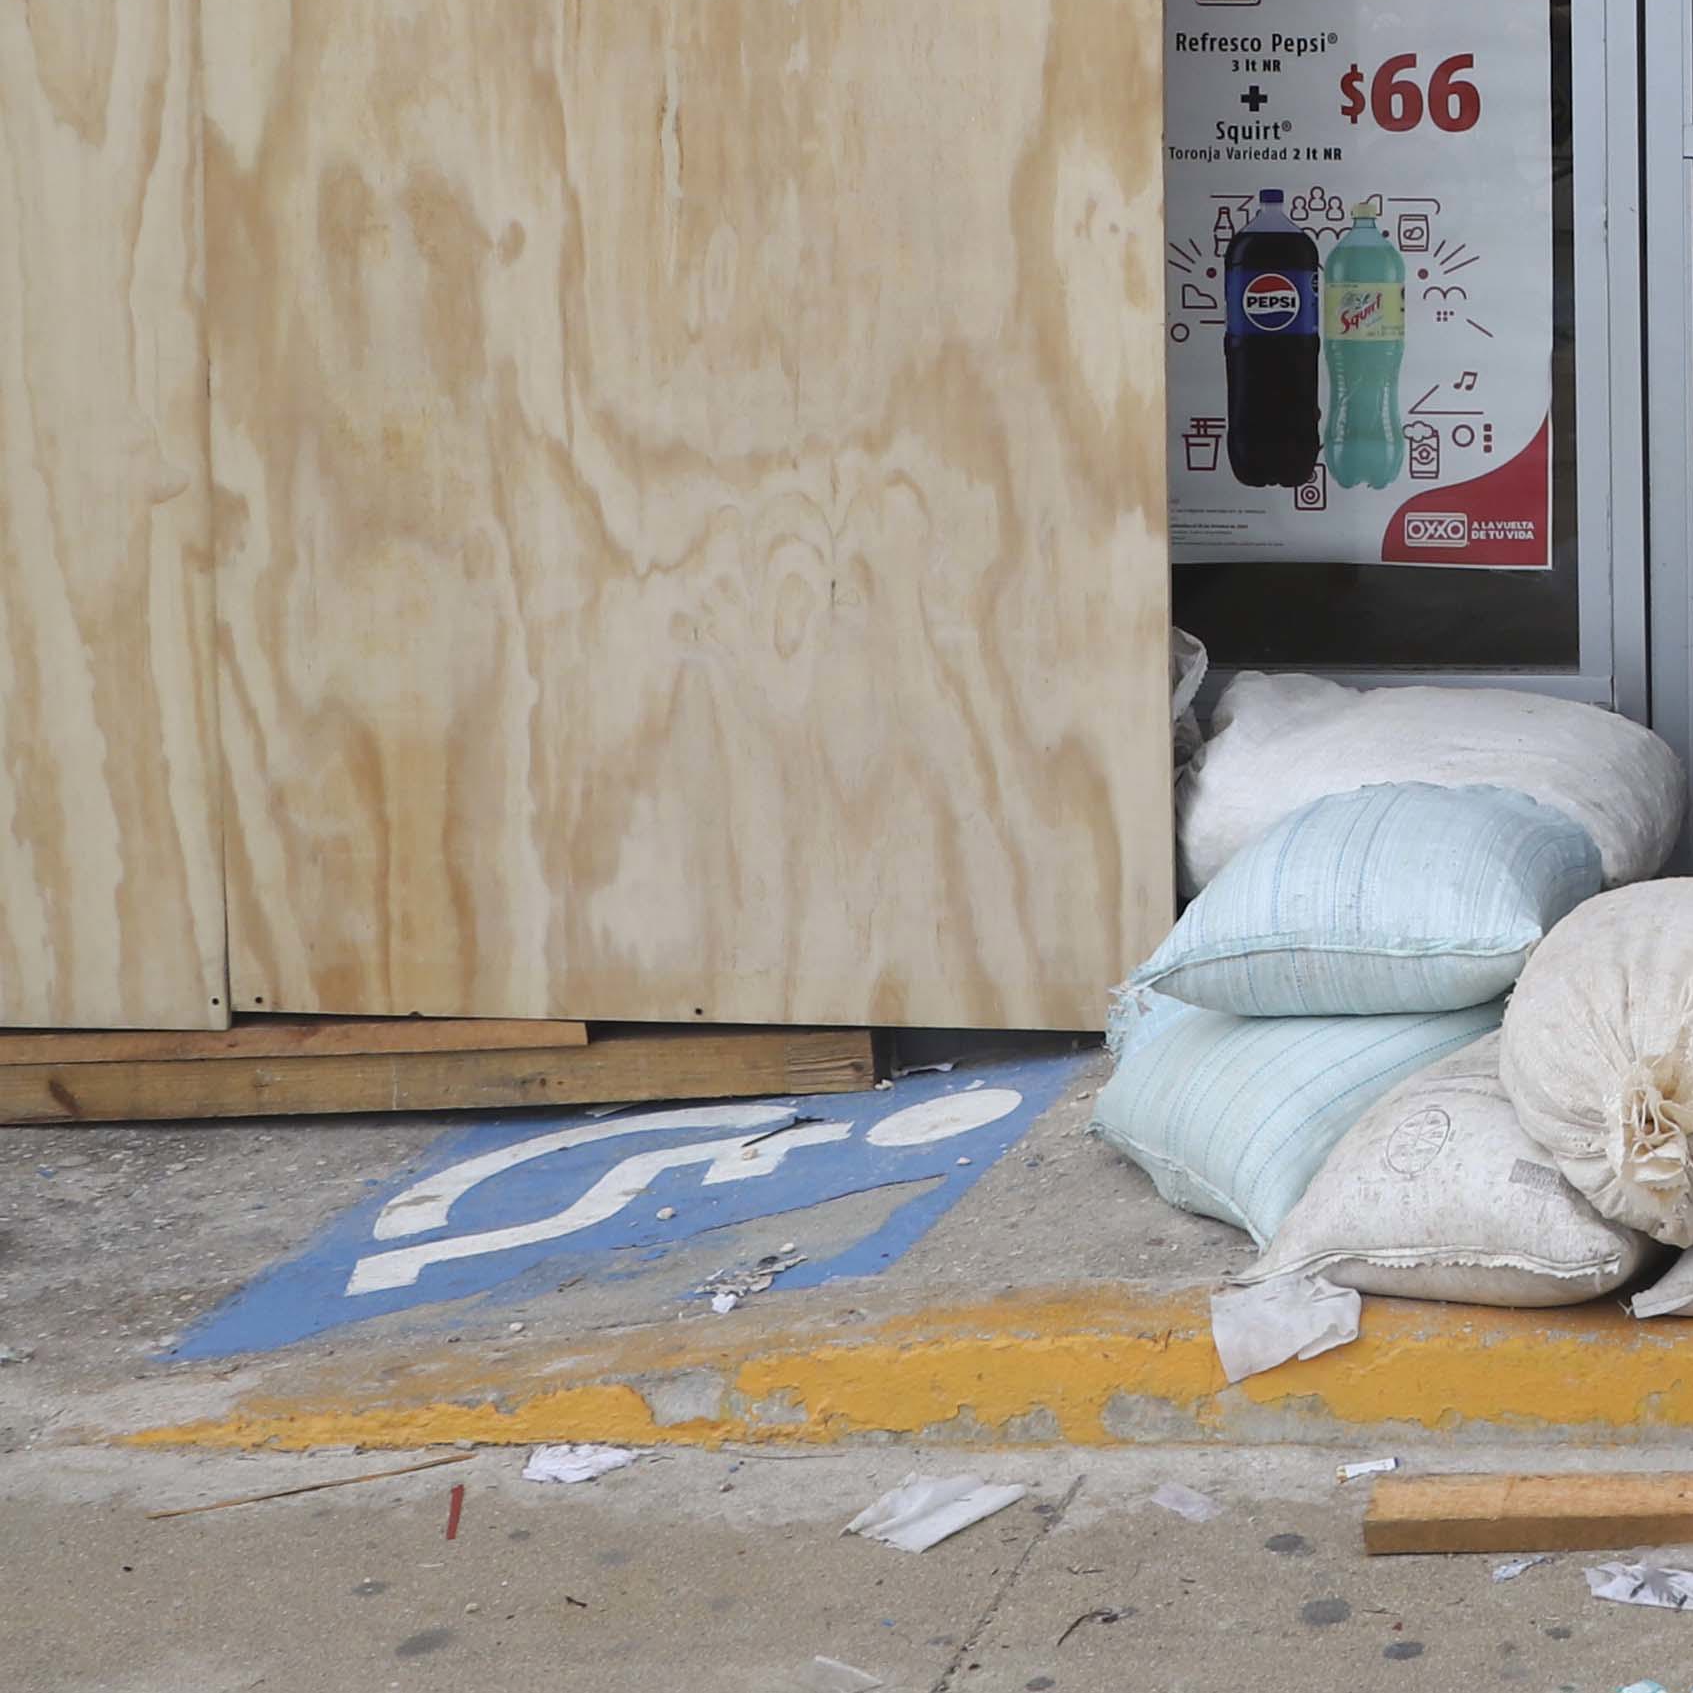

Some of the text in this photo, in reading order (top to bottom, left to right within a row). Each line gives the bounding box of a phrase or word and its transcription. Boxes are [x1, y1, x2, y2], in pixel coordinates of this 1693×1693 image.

[1175, 32, 1262, 53] Refresco
[1232, 60, 1240, 73] 3
[1263, 59, 1281, 73] NR
[1340, 53, 1481, 133] $66
[1169, 146, 1221, 163] Toronja
[1226, 145, 1288, 161] Variedad
[1293, 147, 1301, 160] 2
[1324, 146, 1342, 161] NR
[1247, 295, 1296, 309] PEPSI
[1341, 292, 1383, 334] Squirt
[1407, 520, 1465, 540] OXXO
[1472, 521, 1534, 530] A LA VUELTA
[1471, 530, 1535, 540] DE TU VIDA
